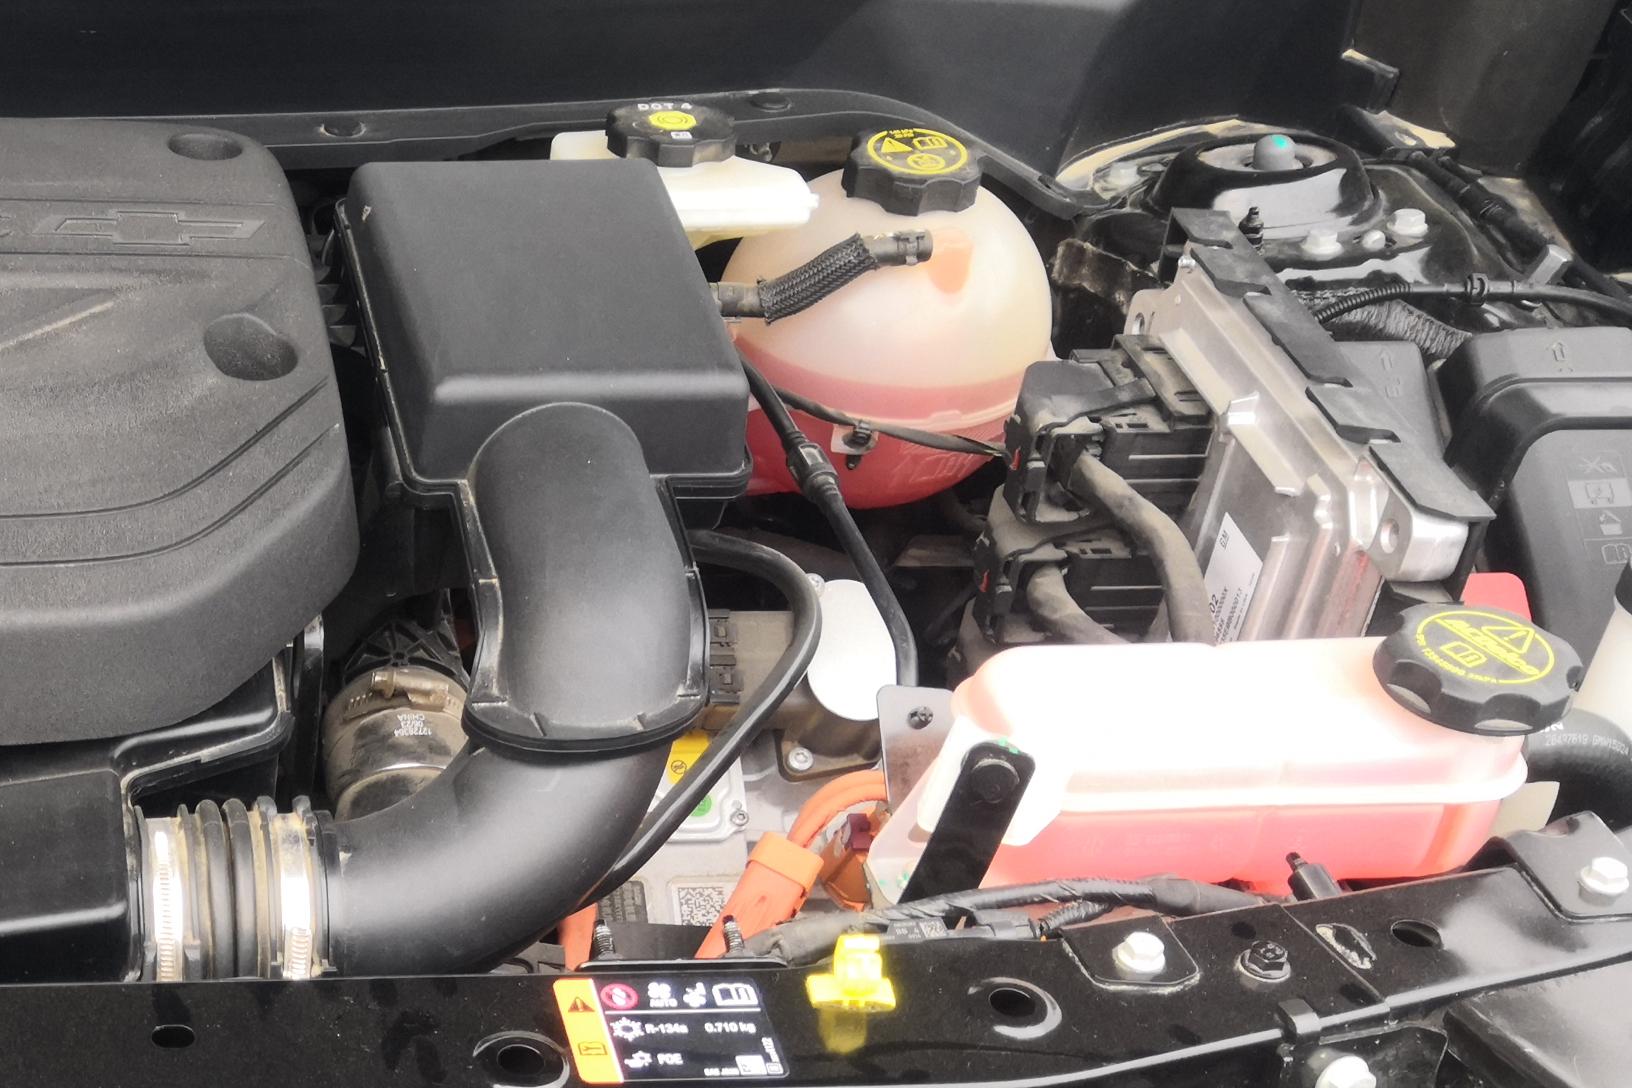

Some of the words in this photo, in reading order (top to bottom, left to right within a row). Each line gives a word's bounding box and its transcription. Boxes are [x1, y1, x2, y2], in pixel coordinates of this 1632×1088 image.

[637, 103, 674, 111] DOT
[645, 1024, 688, 1034] R-134a
[705, 1022, 738, 1033] 0.710
[739, 1022, 756, 1034] kg
